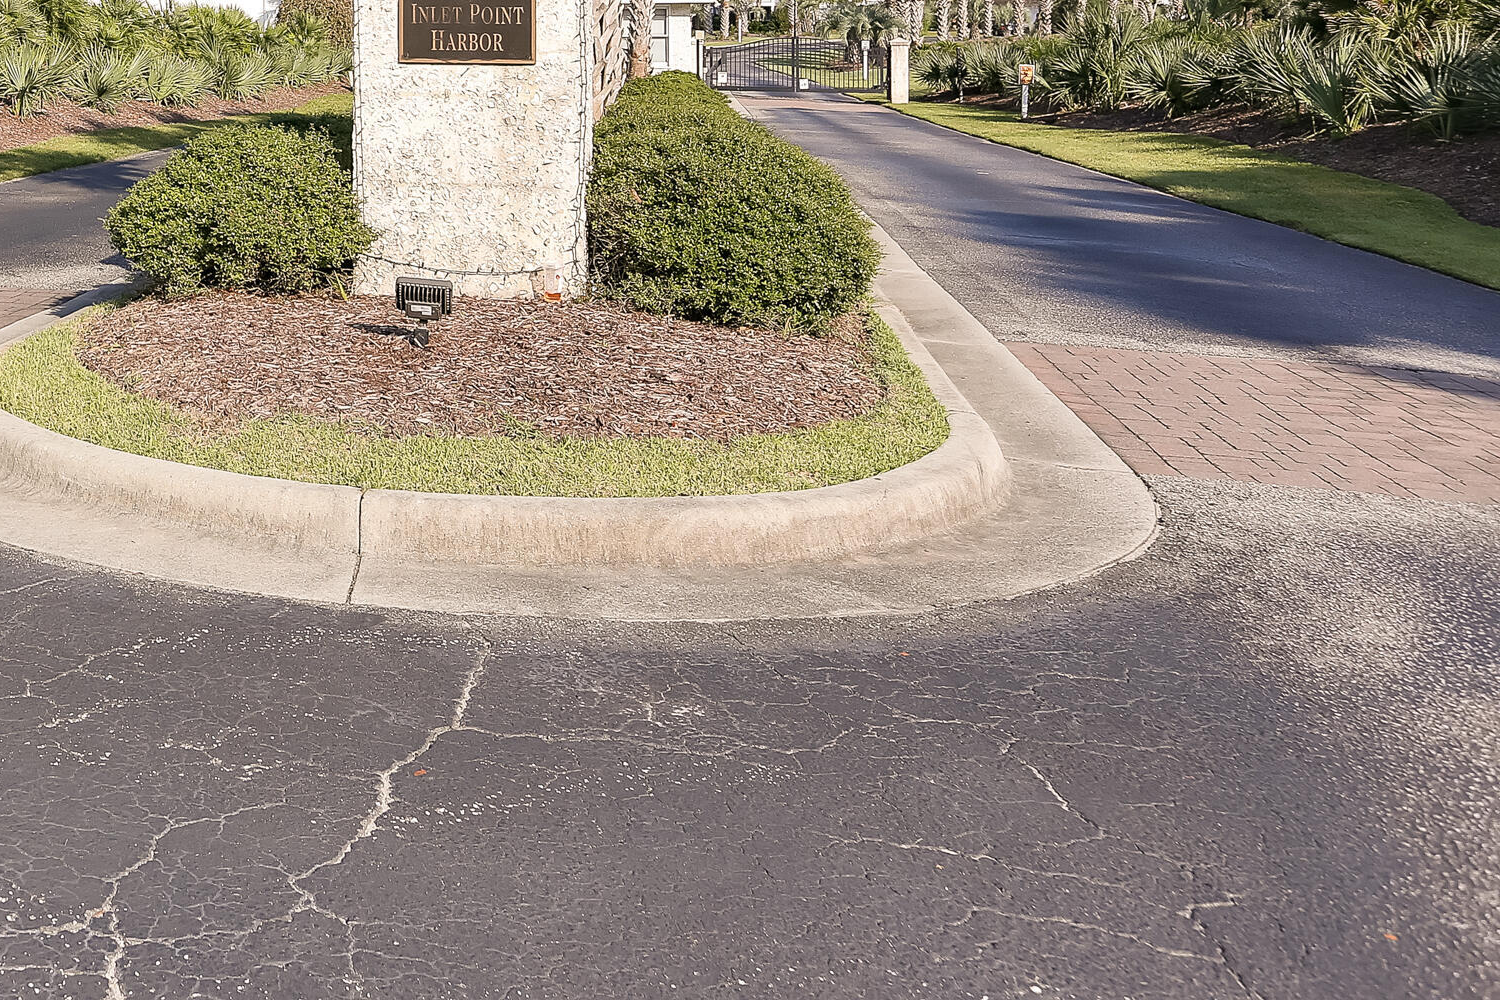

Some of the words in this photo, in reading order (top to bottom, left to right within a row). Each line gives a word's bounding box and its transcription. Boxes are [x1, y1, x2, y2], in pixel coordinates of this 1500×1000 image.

[411, 3, 463, 24] INLET
[469, 3, 525, 25] POINT
[430, 29, 504, 52] HARBOR
